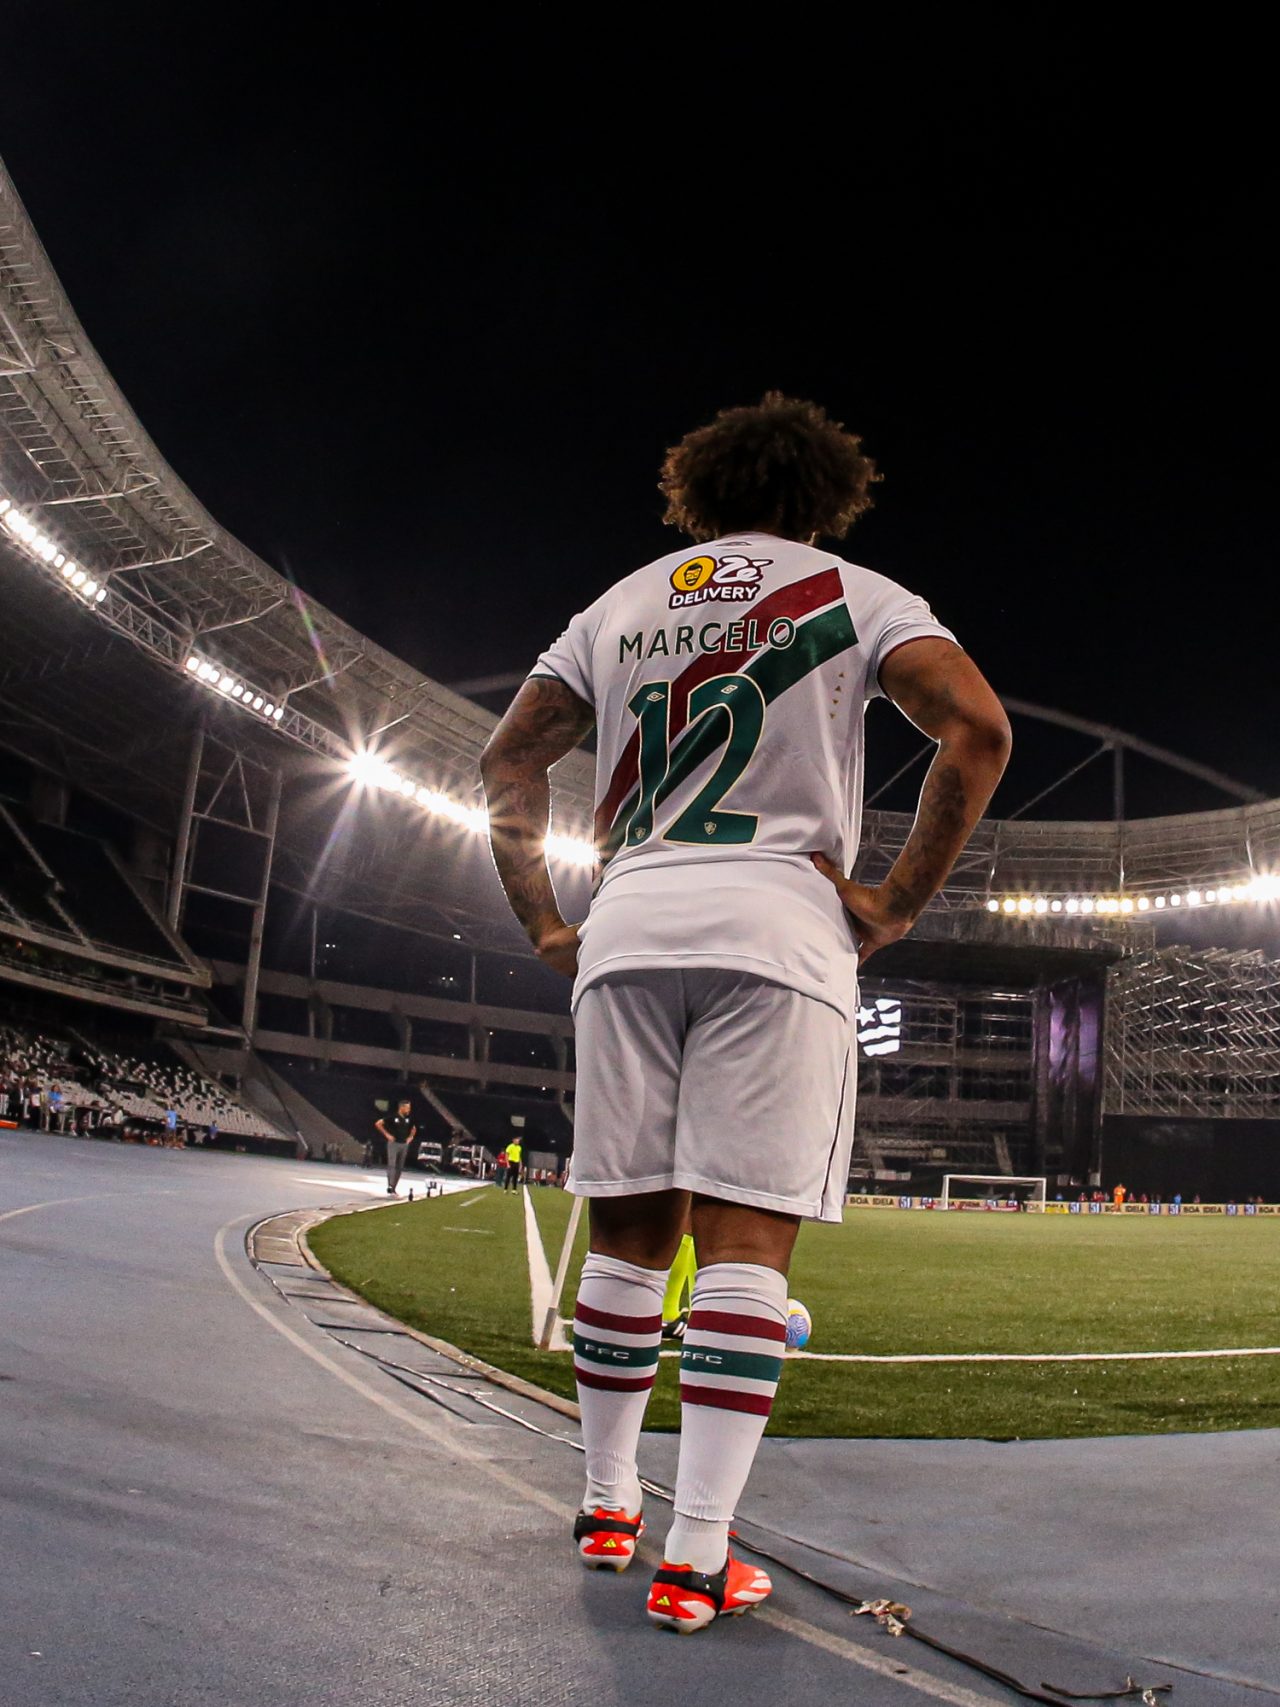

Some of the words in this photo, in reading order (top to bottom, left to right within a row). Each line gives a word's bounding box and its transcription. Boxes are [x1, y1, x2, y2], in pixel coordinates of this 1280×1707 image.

[671, 586, 758, 608] DELIVERY
[617, 616, 798, 663] MARCELO
[626, 673, 766, 847] 12
[900, 1196, 911, 1209] 51
[584, 1343, 630, 1360] FFC
[682, 1351, 723, 1365] FFC
